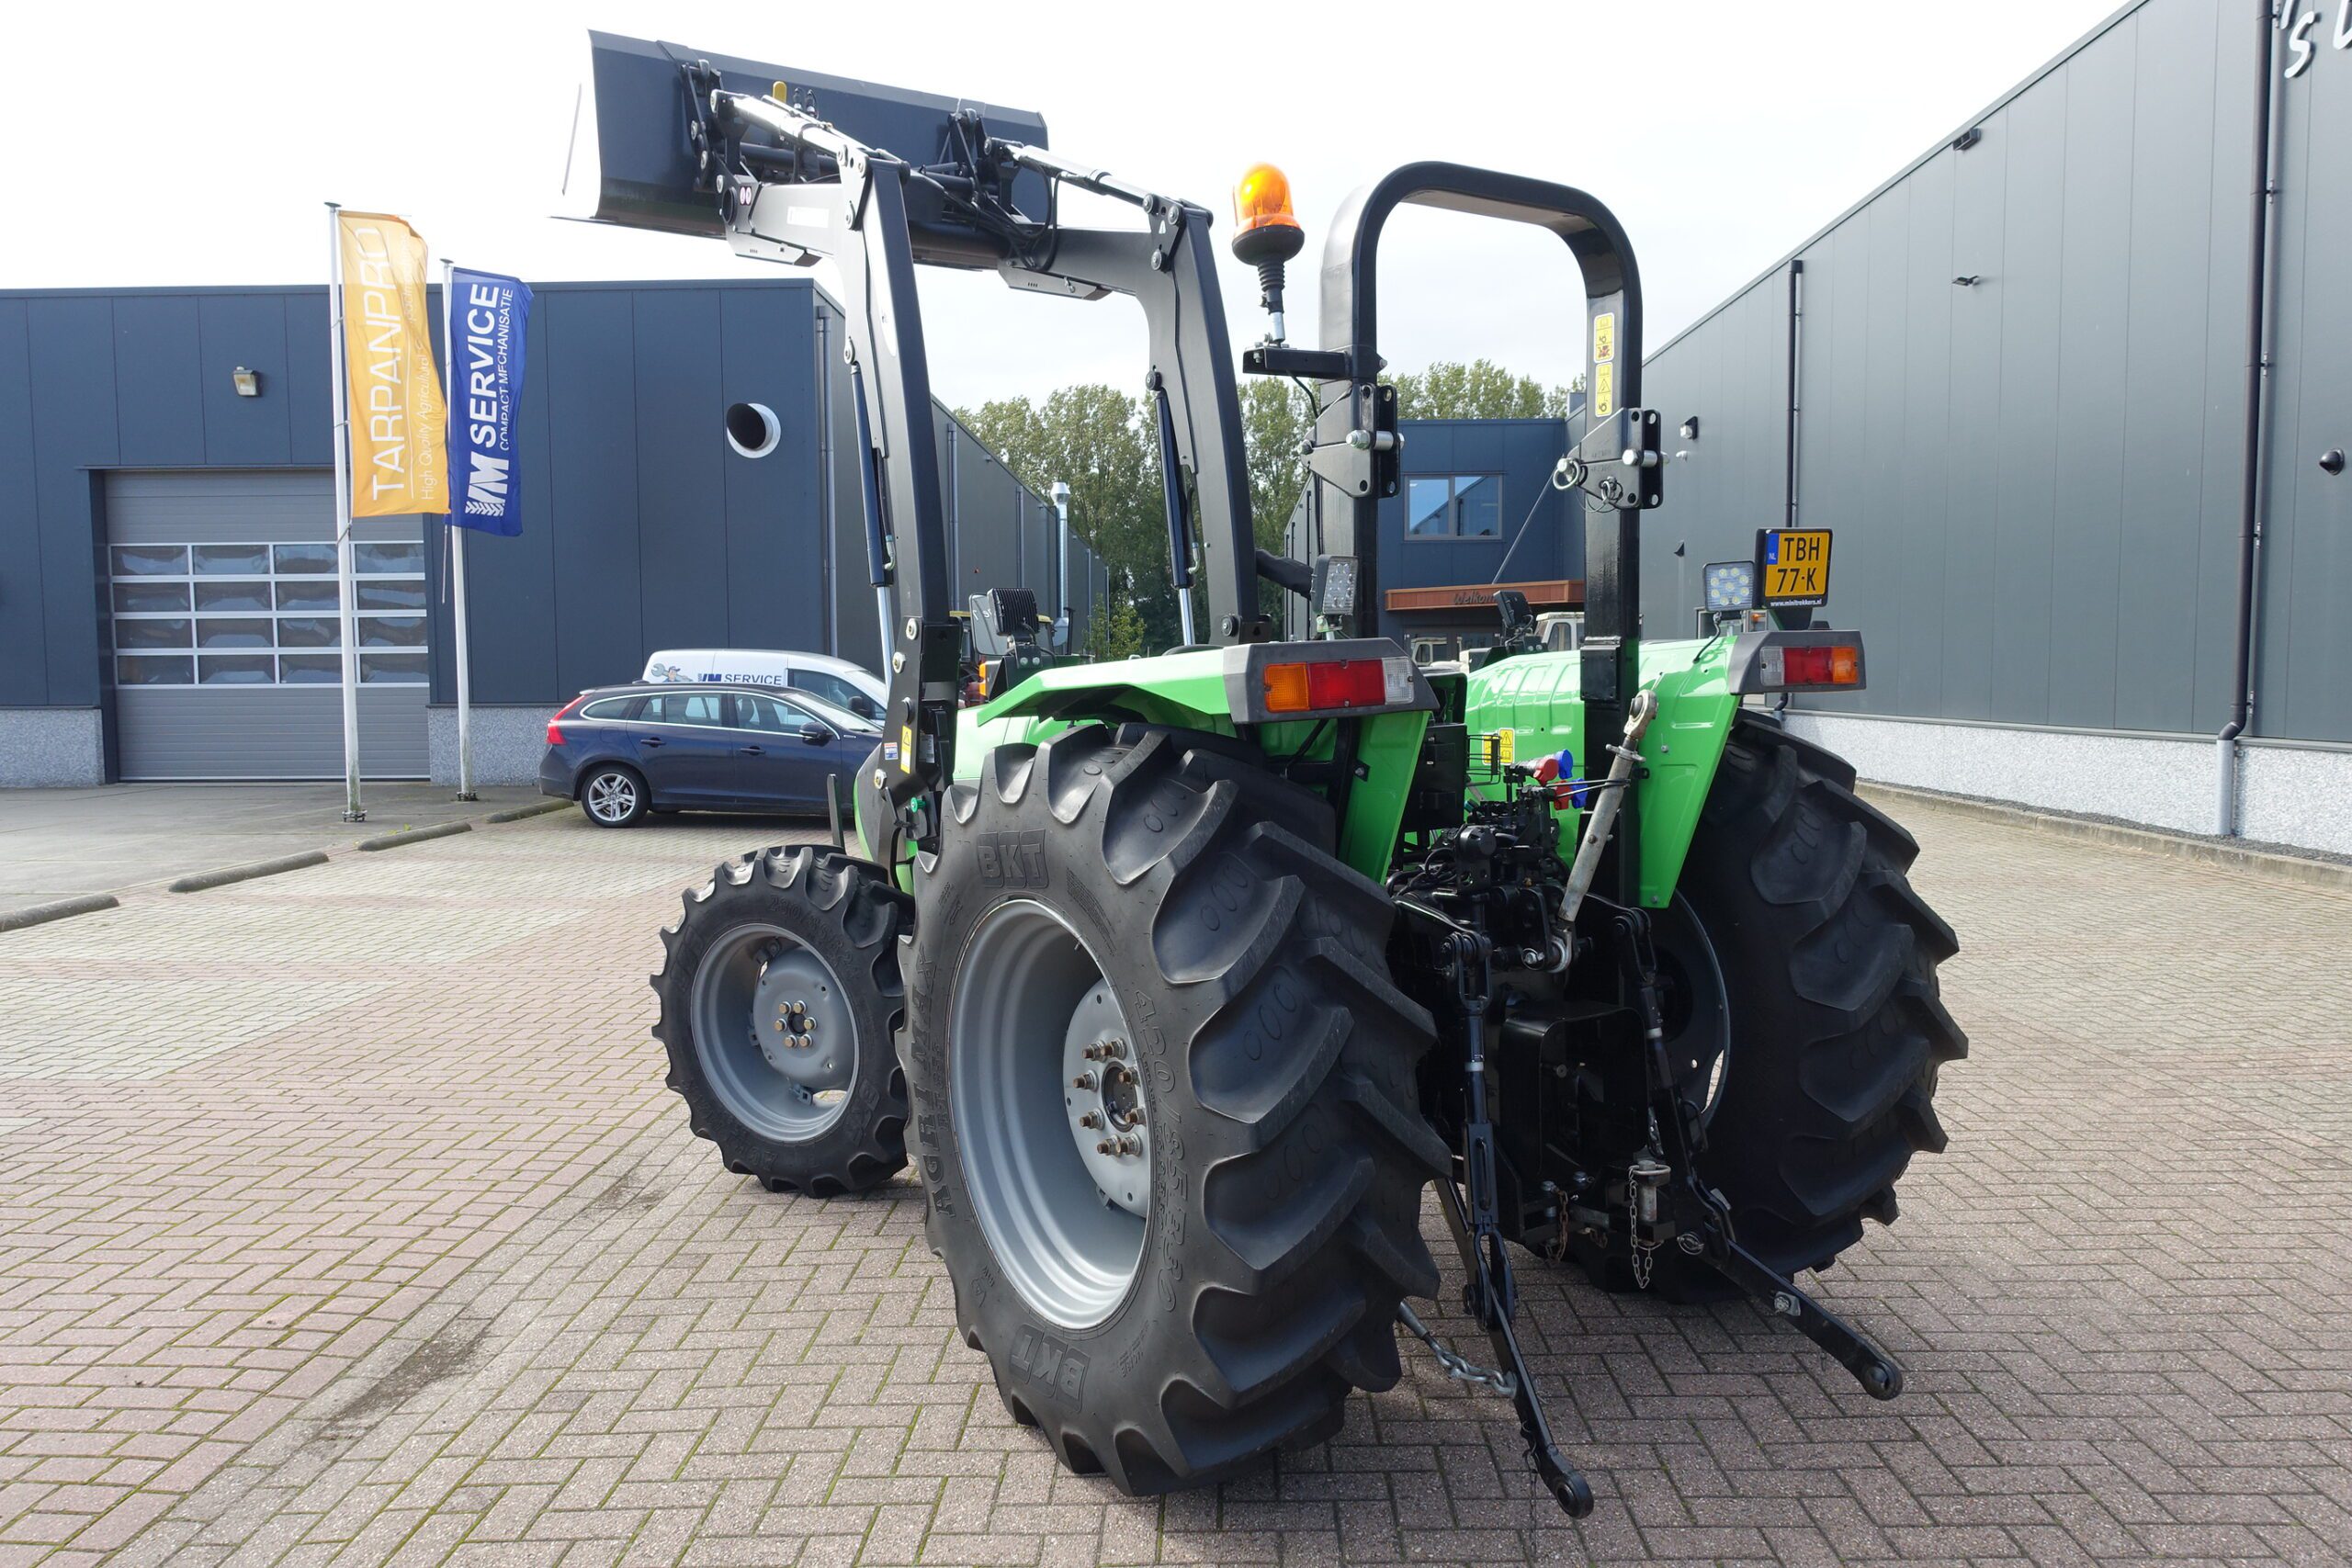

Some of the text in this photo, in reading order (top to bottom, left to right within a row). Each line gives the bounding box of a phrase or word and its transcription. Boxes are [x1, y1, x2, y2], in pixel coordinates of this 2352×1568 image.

[356, 227, 405, 501] TARPANPRO
[467, 284, 499, 448] SERVICE
[497, 288, 514, 451] COMPACT MECHANISATIE
[415, 355, 433, 421] Agricultural
[416, 423, 434, 467] Quality
[419, 469, 437, 500] High
[1784, 536, 1820, 561] TBH
[1770, 599, 1823, 607] www.minitrekkers.nl
[725, 674, 782, 685] SERVICE
[977, 840, 1044, 880] BKT
[1011, 1332, 1087, 1401] BKT
